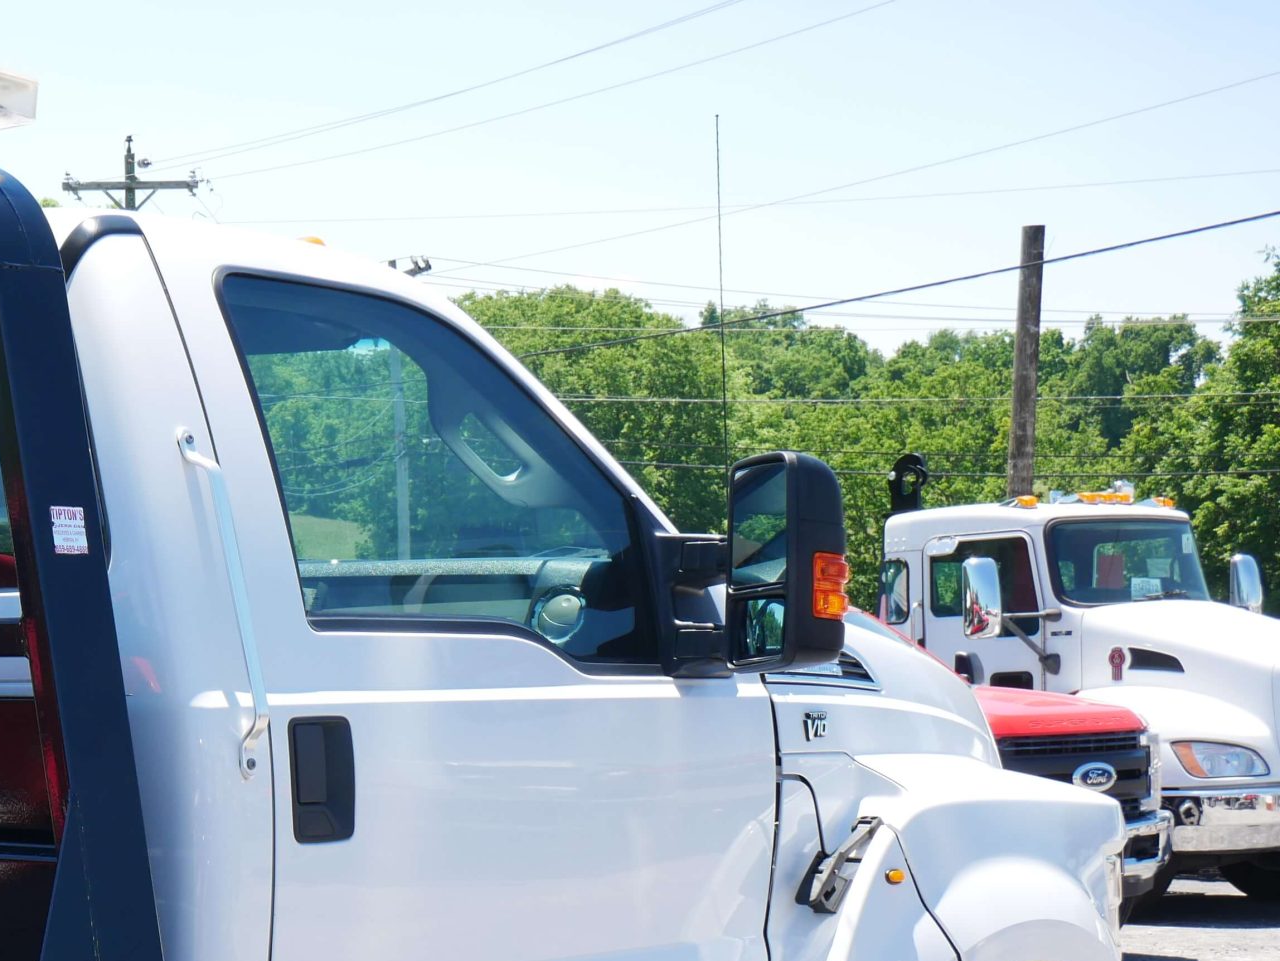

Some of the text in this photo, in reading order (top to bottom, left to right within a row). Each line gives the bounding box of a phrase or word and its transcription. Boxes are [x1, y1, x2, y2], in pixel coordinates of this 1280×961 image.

[50, 508, 84, 520] TIPTON'S
[804, 719, 827, 741] V10
[1086, 769, 1109, 785] Ford
